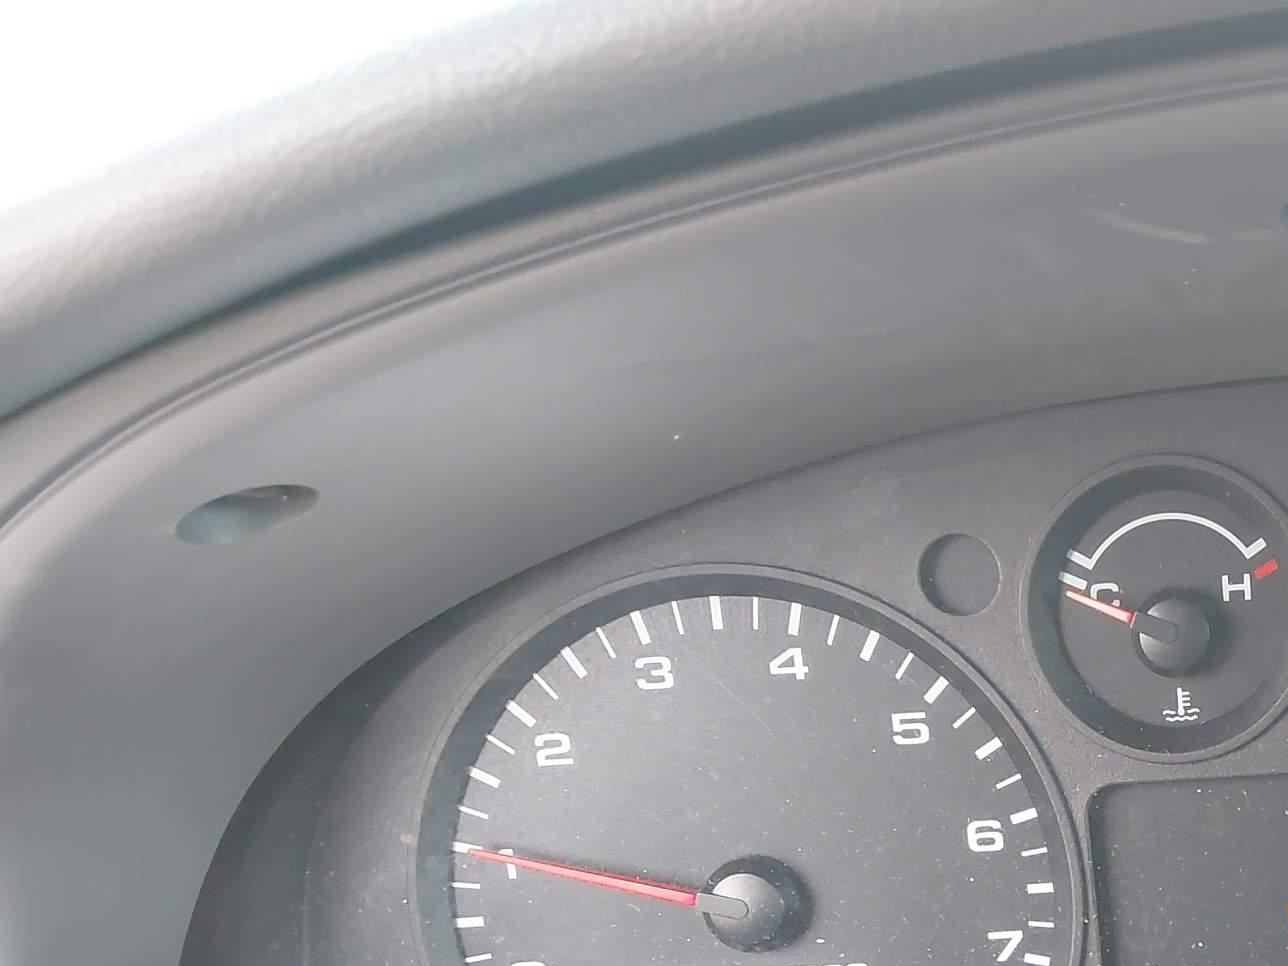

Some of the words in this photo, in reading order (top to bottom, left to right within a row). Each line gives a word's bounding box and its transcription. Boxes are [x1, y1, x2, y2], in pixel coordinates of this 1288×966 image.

[1221, 573, 1252, 602] H
[635, 656, 674, 690] 3
[769, 647, 809, 680] 4
[891, 711, 930, 745] 5
[534, 732, 574, 767] 2
[966, 819, 1004, 853] 6
[987, 930, 1025, 962] 7
